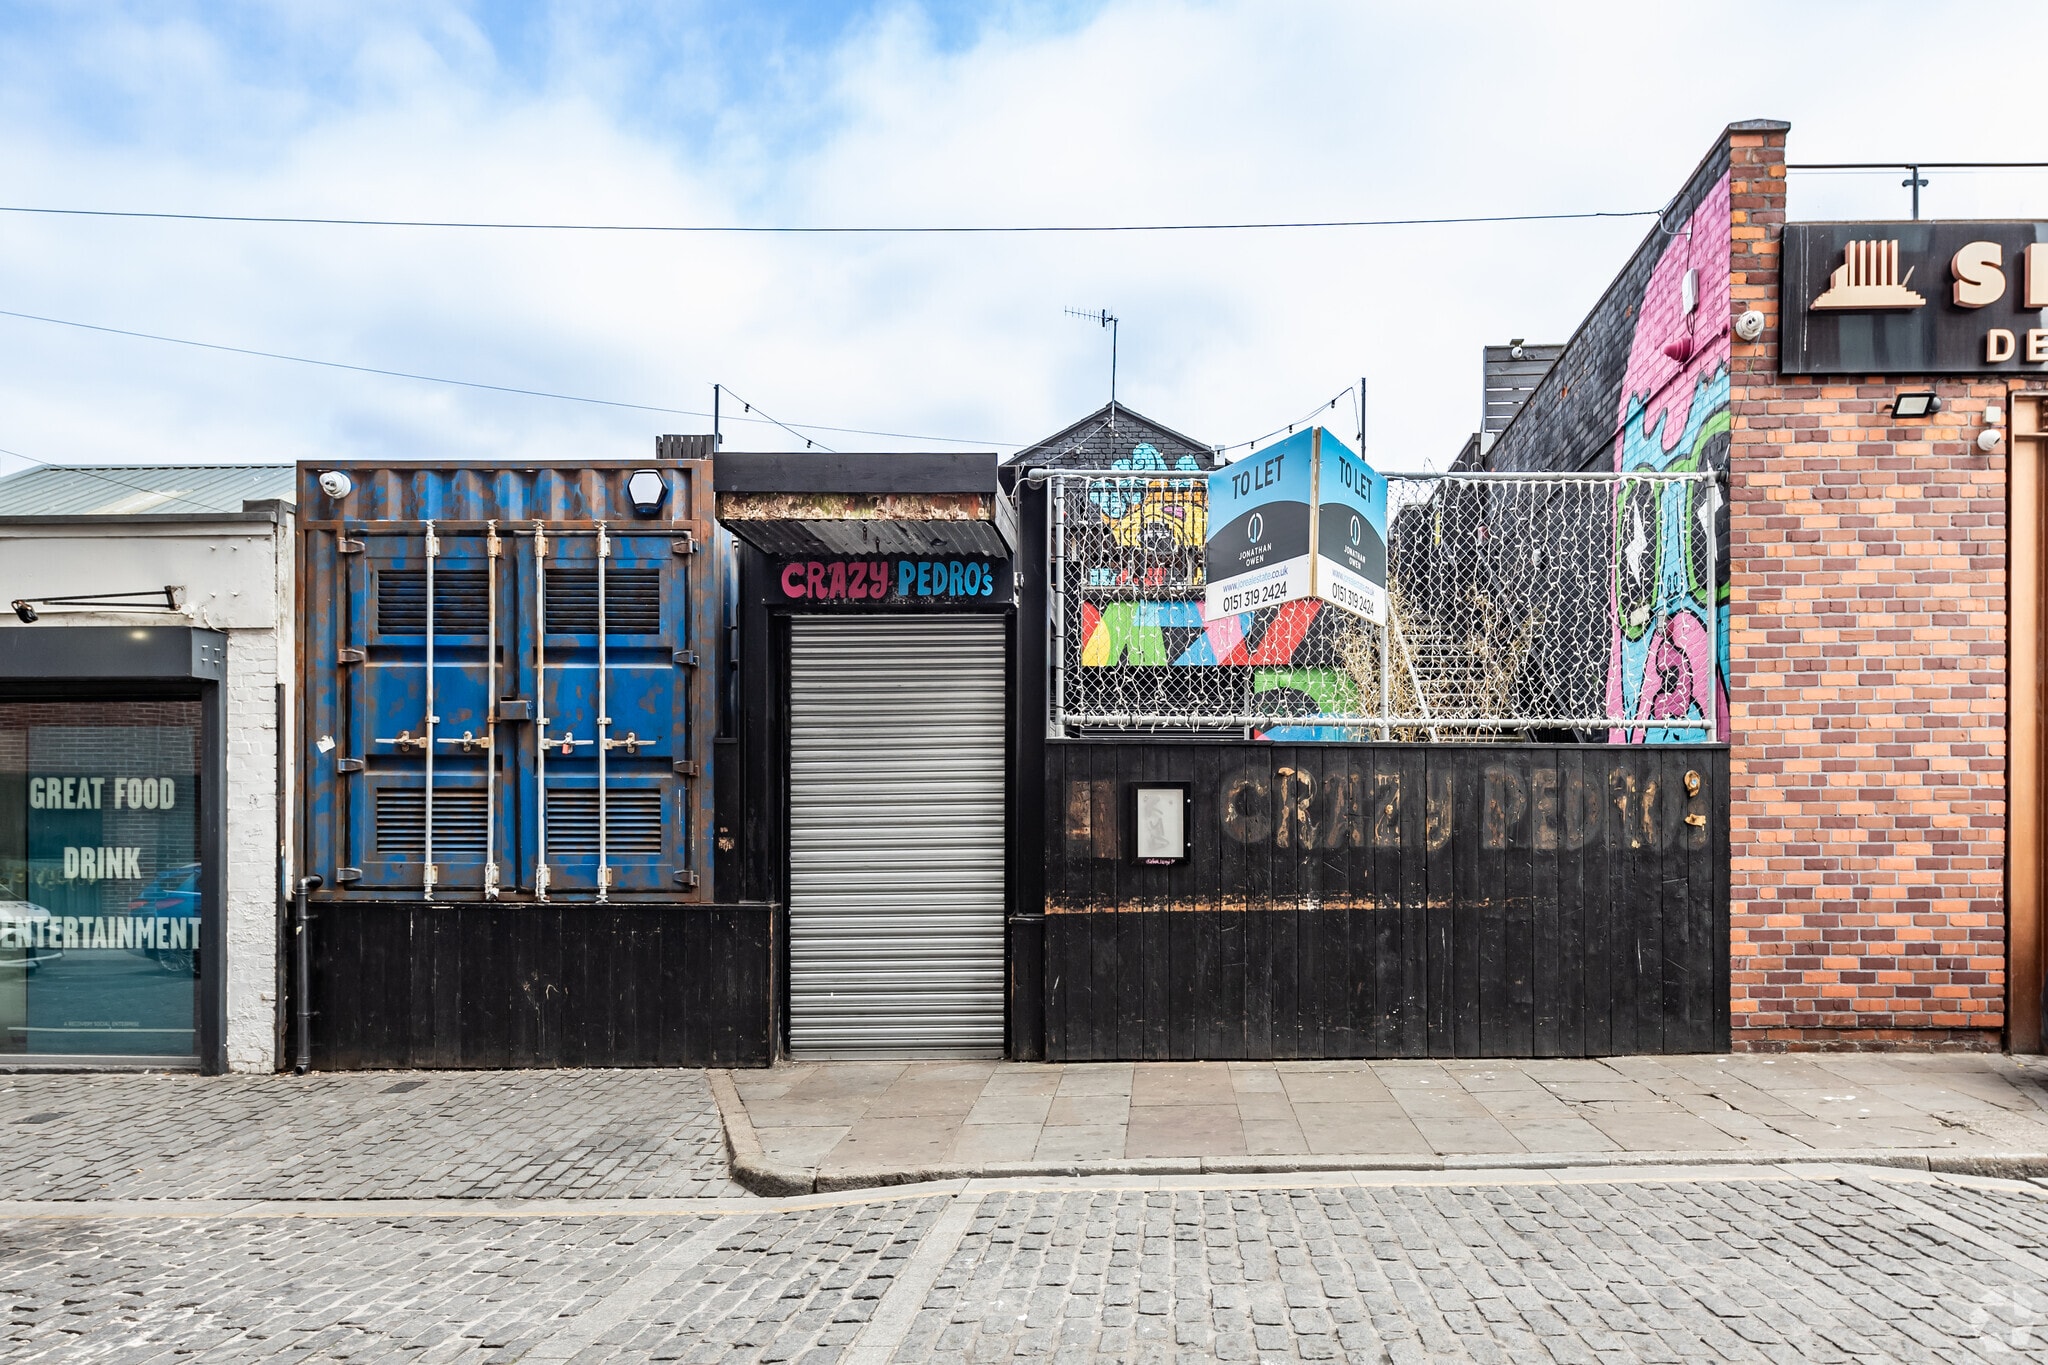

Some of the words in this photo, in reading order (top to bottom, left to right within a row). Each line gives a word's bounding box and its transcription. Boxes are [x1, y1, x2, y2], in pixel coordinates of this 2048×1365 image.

[1232, 470, 1250, 499] TO
[1255, 454, 1285, 491] LET
[1339, 456, 1351, 489] TO
[1355, 470, 1373, 503] LET
[1238, 543, 1272, 561] JONATHAN
[1245, 555, 1264, 567] OWEN
[1344, 545, 1366, 564] JONATHAN
[1349, 556, 1361, 570] OWEN
[781, 561, 890, 600] CRAZY
[1223, 565, 1289, 593] www.jorealestate.co.uk
[1223, 594, 1242, 612] 0151
[1244, 588, 1260, 607] 319
[1262, 581, 1287, 603] 2424
[1332, 582, 1347, 603] 0151
[1347, 590, 1358, 608] 319
[1359, 596, 1374, 615] 2424
[30, 777, 105, 809] GREAT
[114, 777, 175, 810] FOOD
[63, 847, 142, 879] DRINK
[1, 916, 202, 949] ENTERTAINMENT
